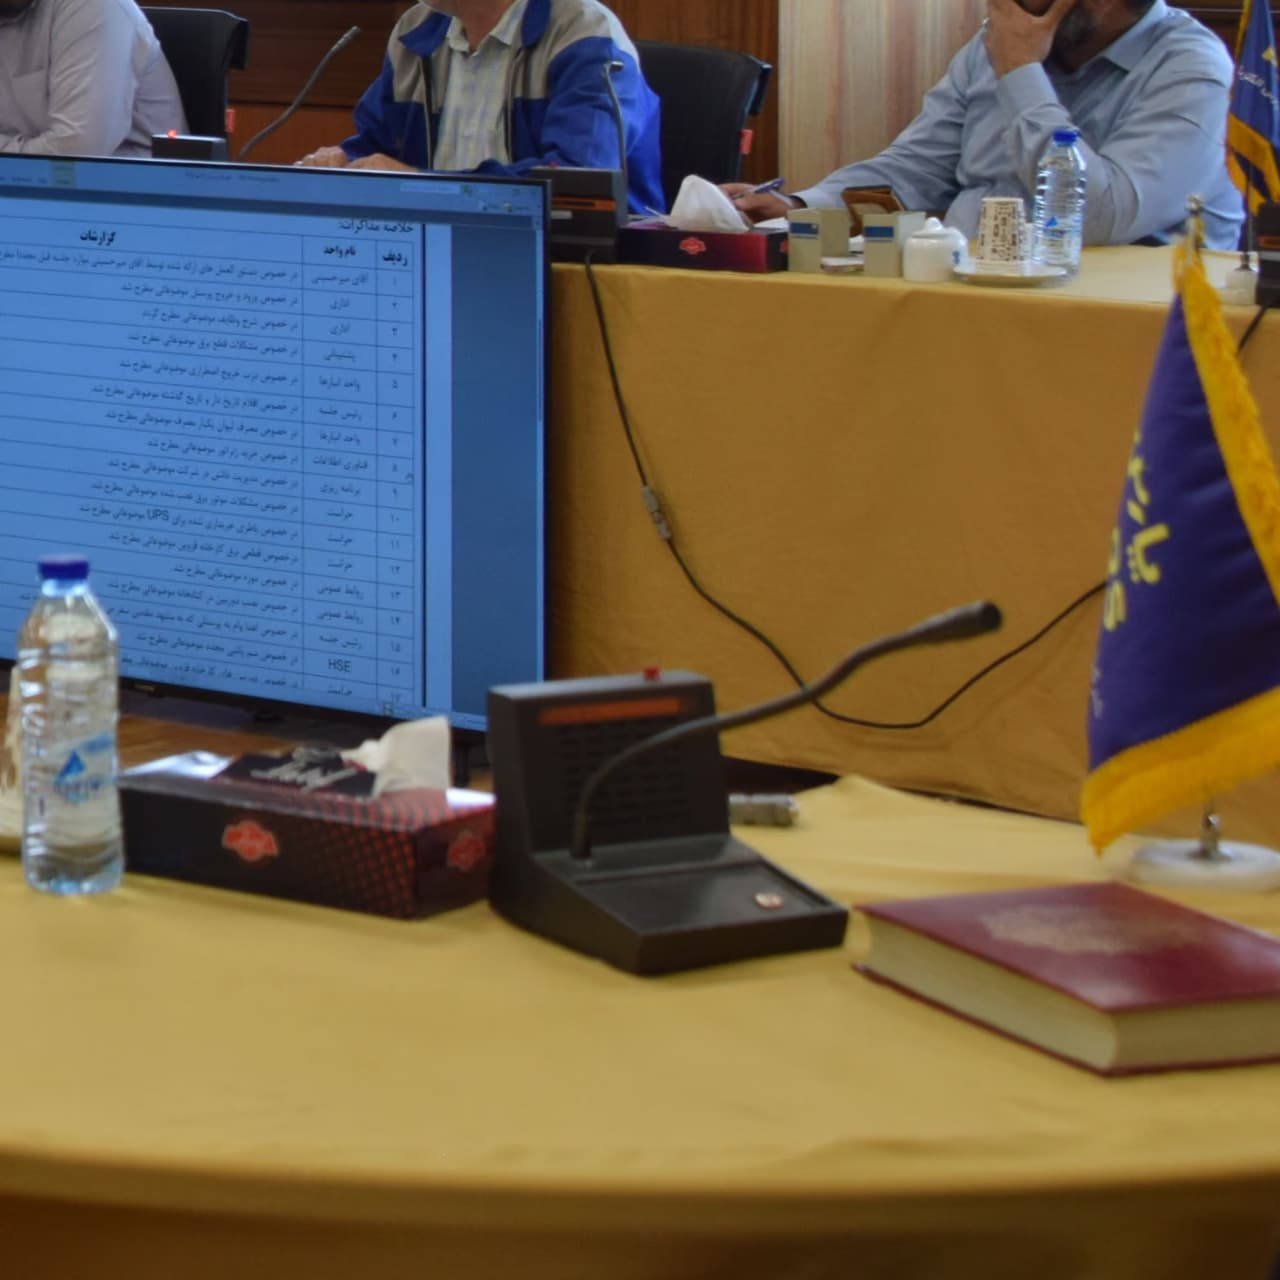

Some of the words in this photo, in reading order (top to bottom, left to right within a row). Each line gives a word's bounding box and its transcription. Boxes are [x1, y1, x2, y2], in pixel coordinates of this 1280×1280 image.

[79, 227, 116, 246] گزارشات
[323, 244, 343, 259] واحد
[382, 247, 408, 267] ردیف
[146, 507, 168, 522] UPS
[327, 656, 352, 673] HSE
